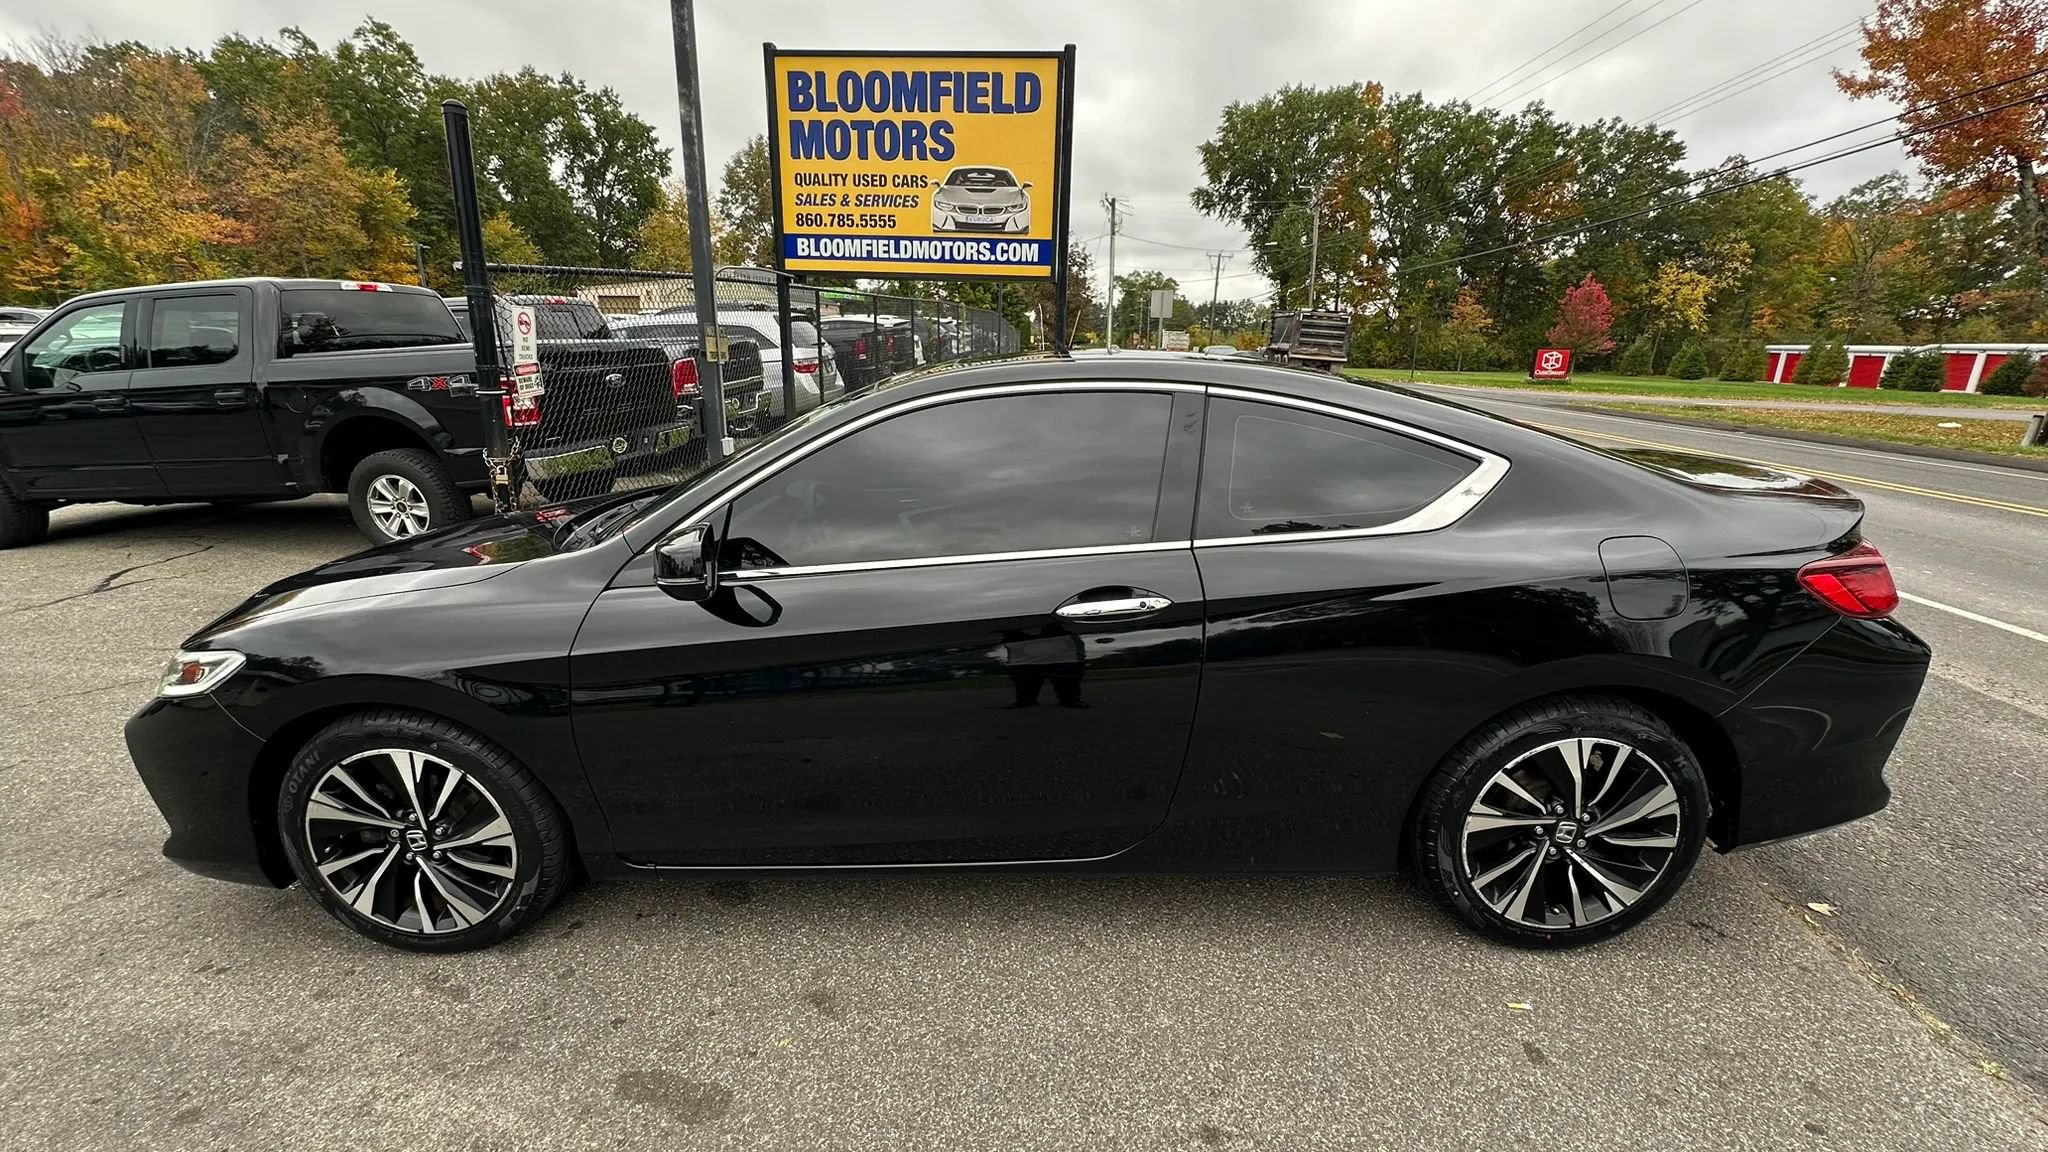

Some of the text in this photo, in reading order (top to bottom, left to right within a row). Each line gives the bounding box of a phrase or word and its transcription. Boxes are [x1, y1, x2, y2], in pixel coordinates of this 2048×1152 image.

[787, 70, 1042, 114] BLOOMFIELD
[788, 119, 955, 161] MOTORS
[794, 172, 929, 189] QUALITY USED CARS
[795, 193, 919, 208] SALES & SERVICES
[795, 213, 897, 229] 860.785.5555
[796, 237, 1039, 263] BLOOMFIELDMOTORS.COM
